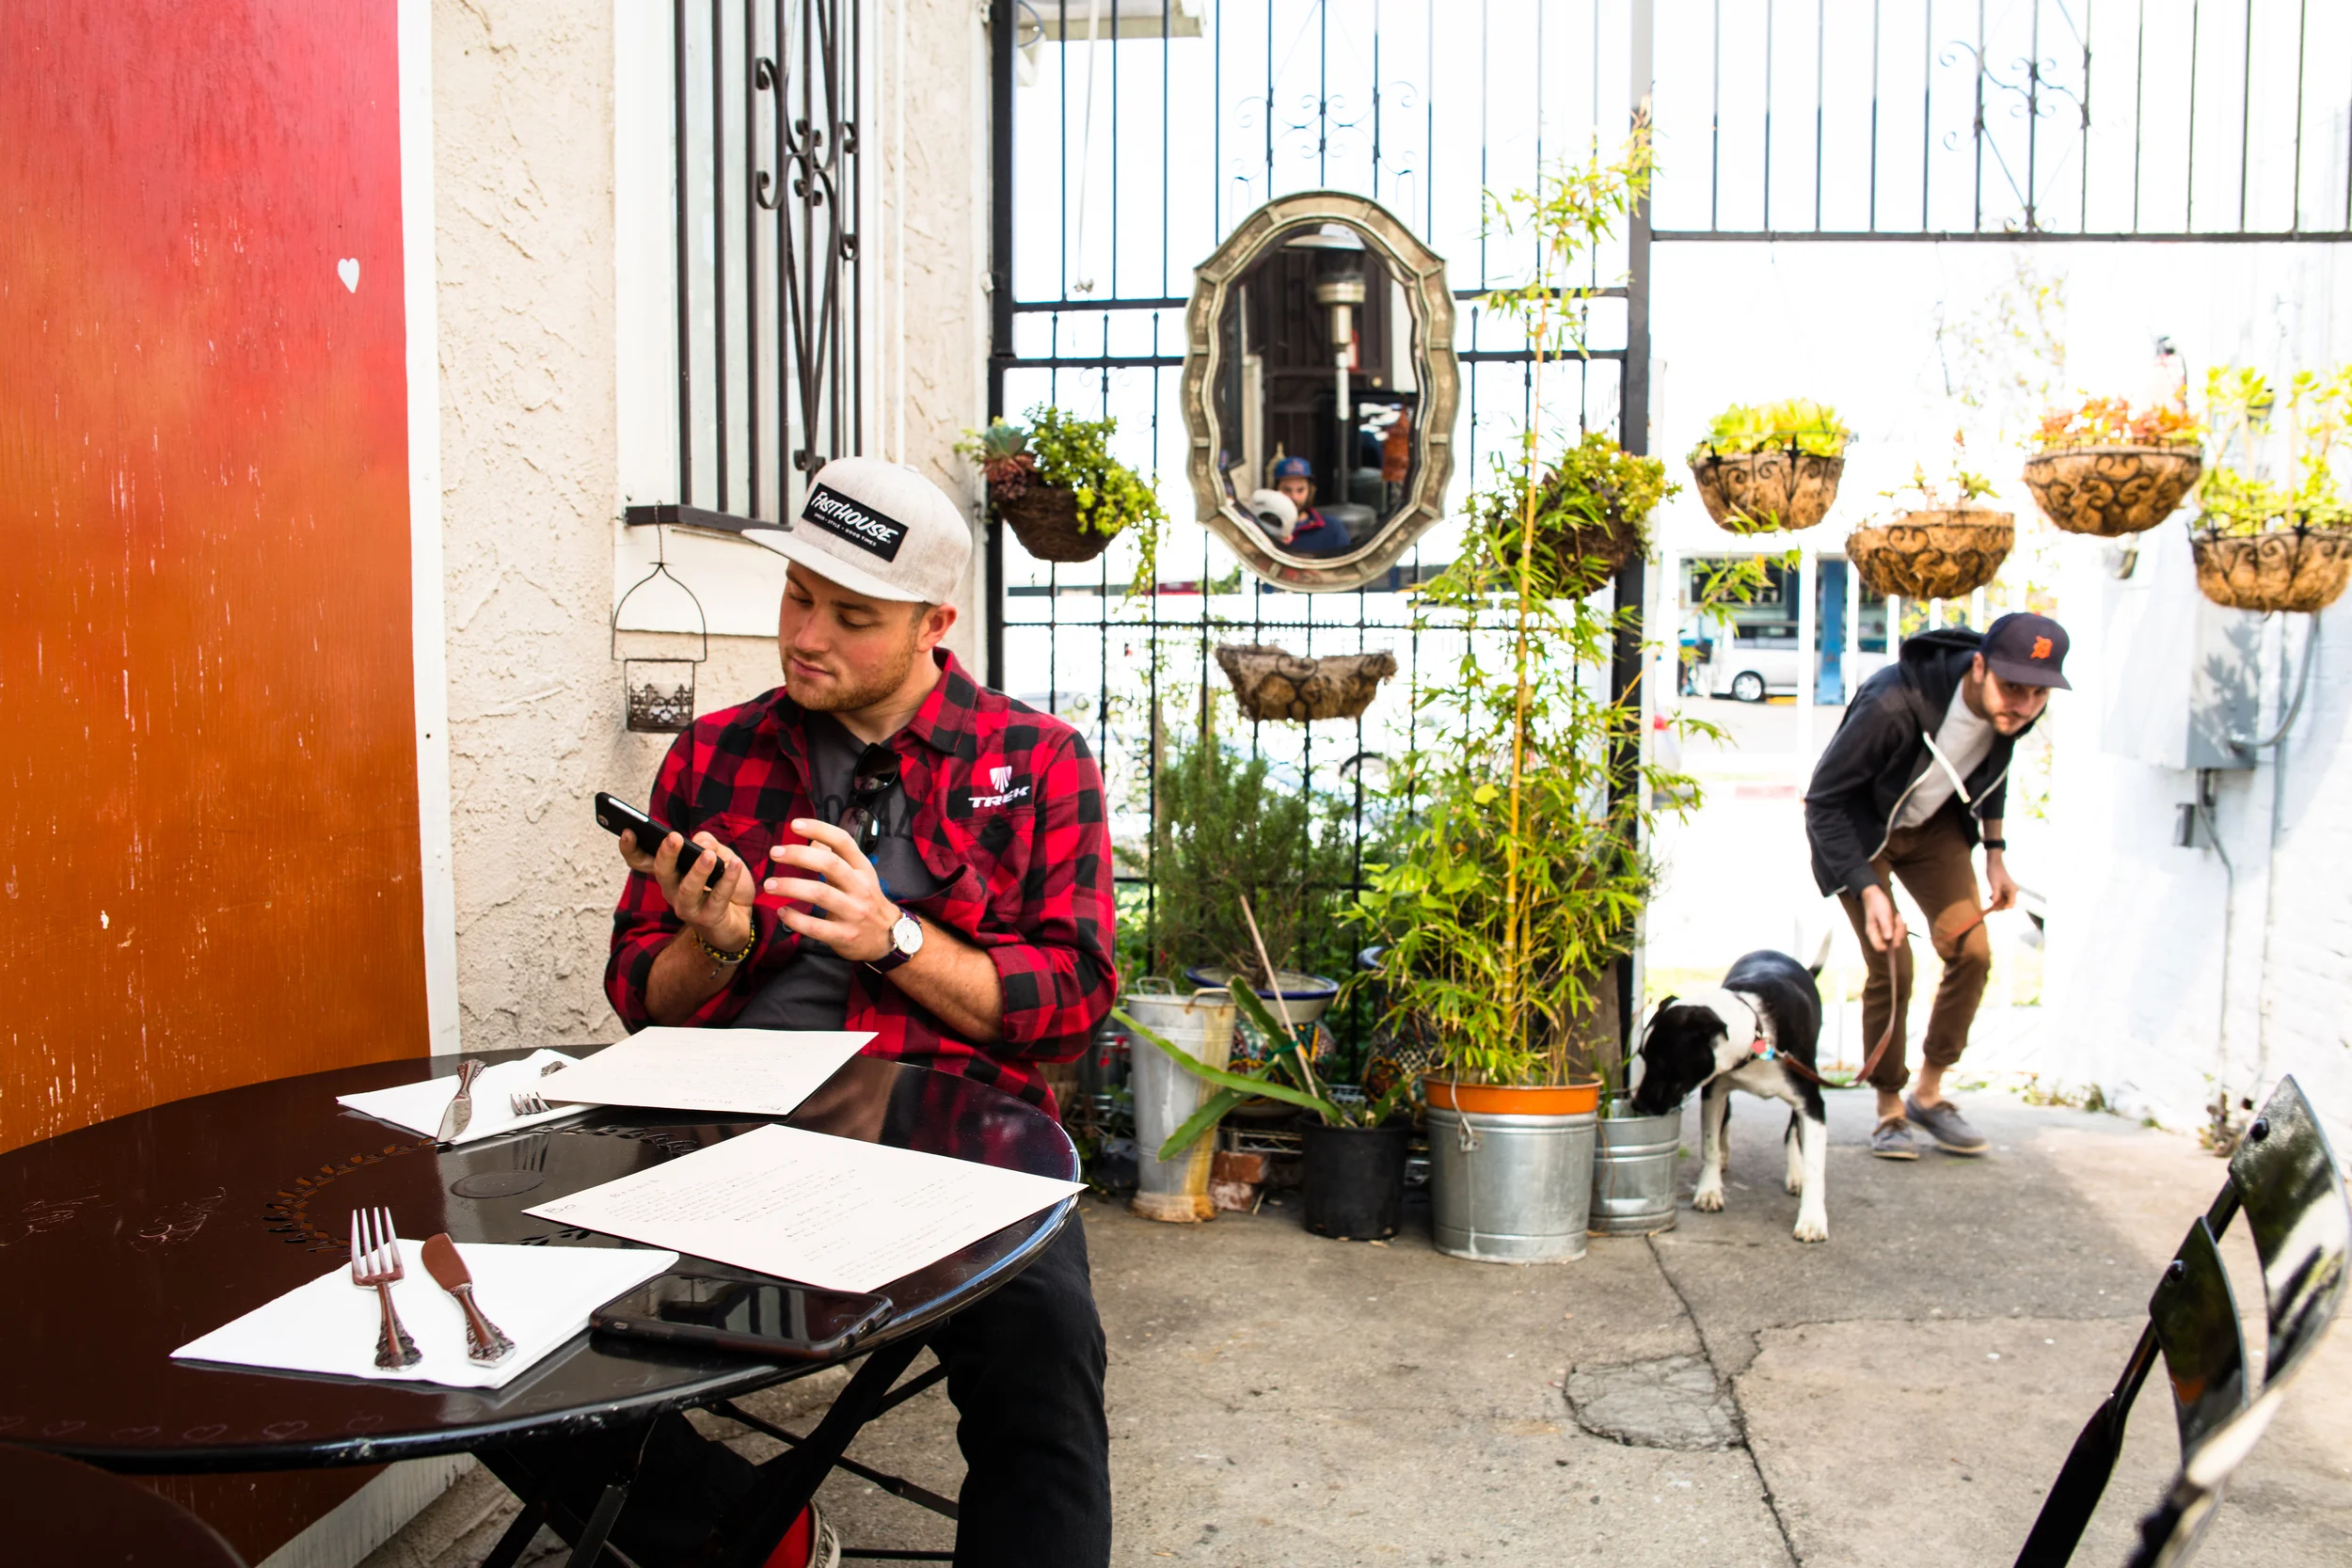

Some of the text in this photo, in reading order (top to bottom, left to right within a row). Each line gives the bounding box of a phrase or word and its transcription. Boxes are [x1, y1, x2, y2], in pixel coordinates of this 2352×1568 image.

[811, 491, 898, 543] FASTHOUSE
[827, 518, 841, 529] STYLE
[845, 528, 860, 539] GOOD
[861, 535, 877, 546] TIMES
[968, 785, 1030, 808] TREK
